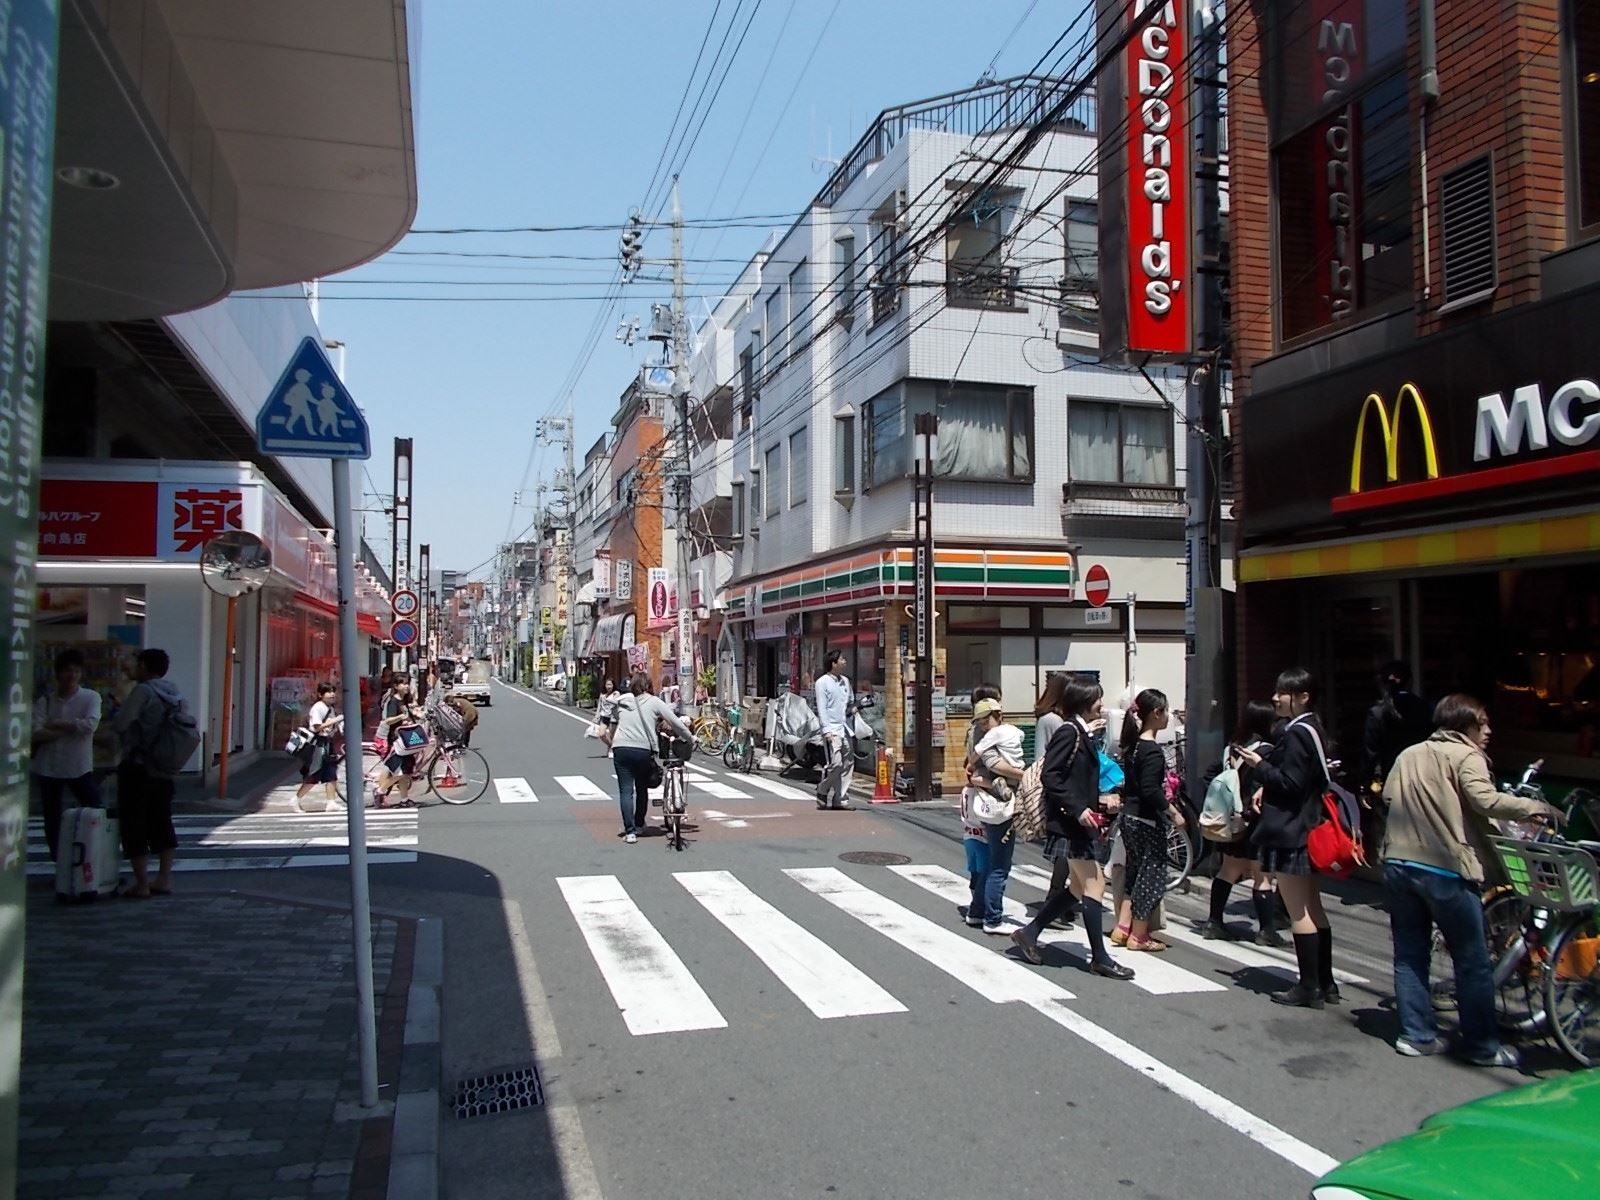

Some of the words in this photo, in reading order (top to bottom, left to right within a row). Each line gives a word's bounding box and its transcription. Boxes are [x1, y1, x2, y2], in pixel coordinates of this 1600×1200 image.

[17, 40, 52, 520] Higashimukoujima
[1133, 0, 1183, 315] McDonald's
[398, 597, 413, 610] 20
